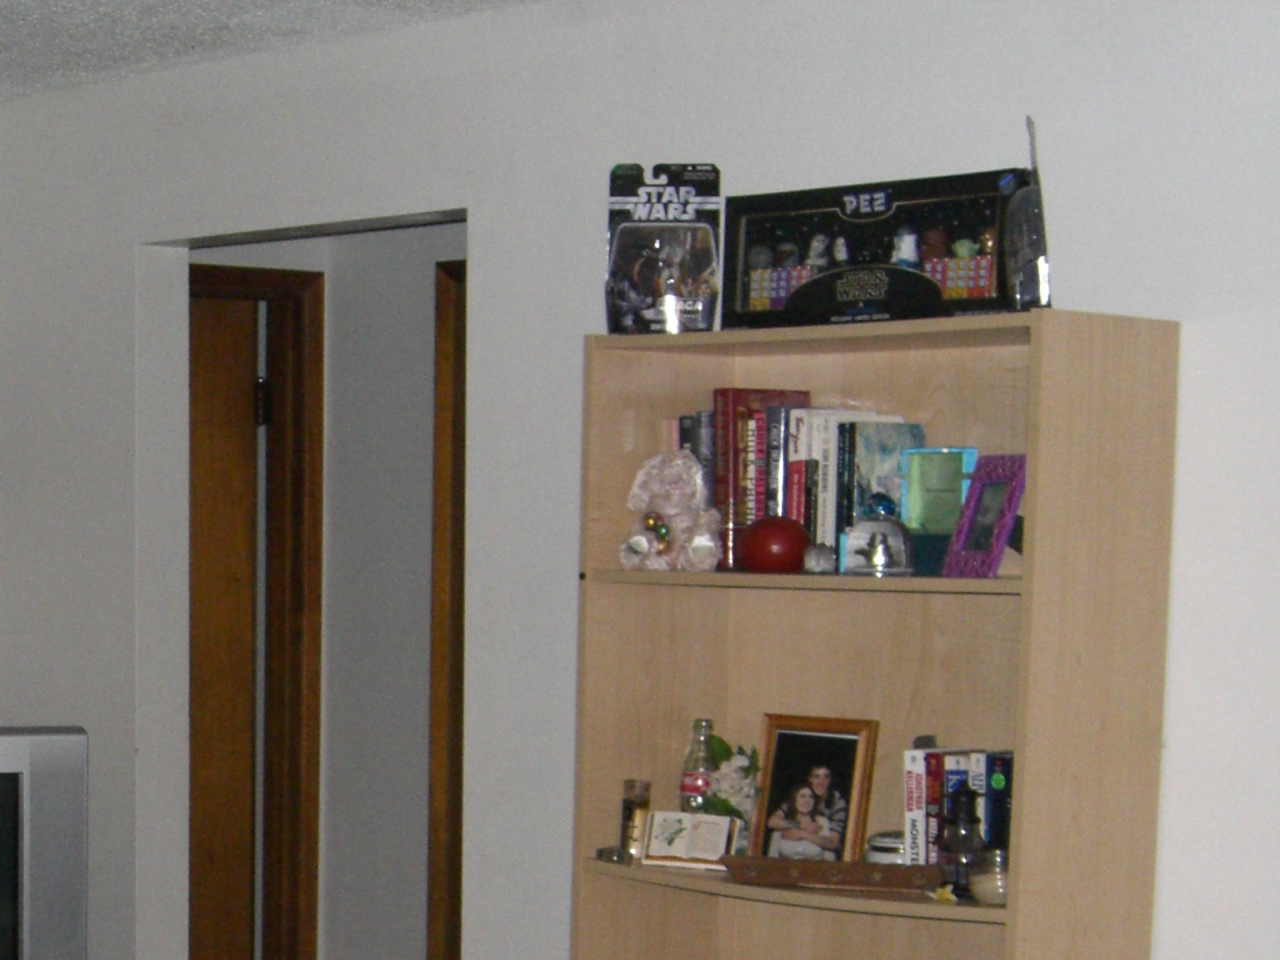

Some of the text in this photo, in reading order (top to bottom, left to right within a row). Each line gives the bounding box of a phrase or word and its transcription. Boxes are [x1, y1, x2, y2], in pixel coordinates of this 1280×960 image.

[637, 186, 696, 203] STAR
[842, 192, 886, 214] PEZ
[632, 203, 696, 221] WARS
[837, 269, 889, 285] STAR
[836, 281, 889, 301] WARS
[909, 818, 919, 863] MONSTE
